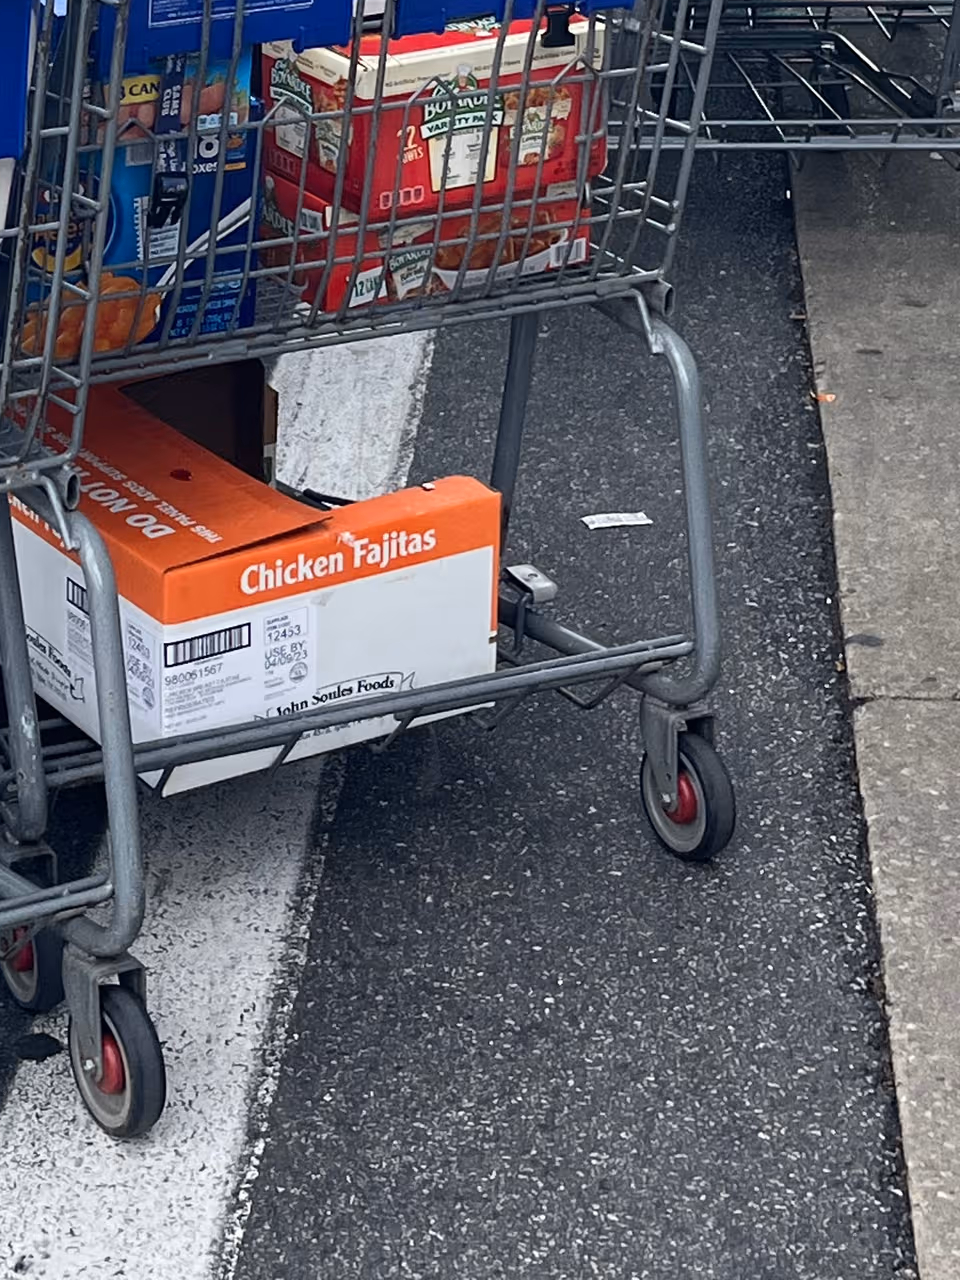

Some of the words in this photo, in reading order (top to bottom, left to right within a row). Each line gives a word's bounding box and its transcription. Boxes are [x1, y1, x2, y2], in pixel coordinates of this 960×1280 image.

[78, 447, 128, 482] SUPPOR
[122, 479, 160, 503] ADDS
[155, 499, 196, 528] PANEL
[190, 524, 223, 544] THIS
[78, 479, 138, 515] NOT
[125, 513, 176, 540] DO
[240, 550, 344, 596] Chicken
[352, 528, 437, 569] Fajitas
[264, 646, 287, 660] USE
[267, 624, 302, 642] 12453
[276, 699, 309, 717] John
[311, 684, 354, 706] Soules
[356, 675, 396, 695] Foods
